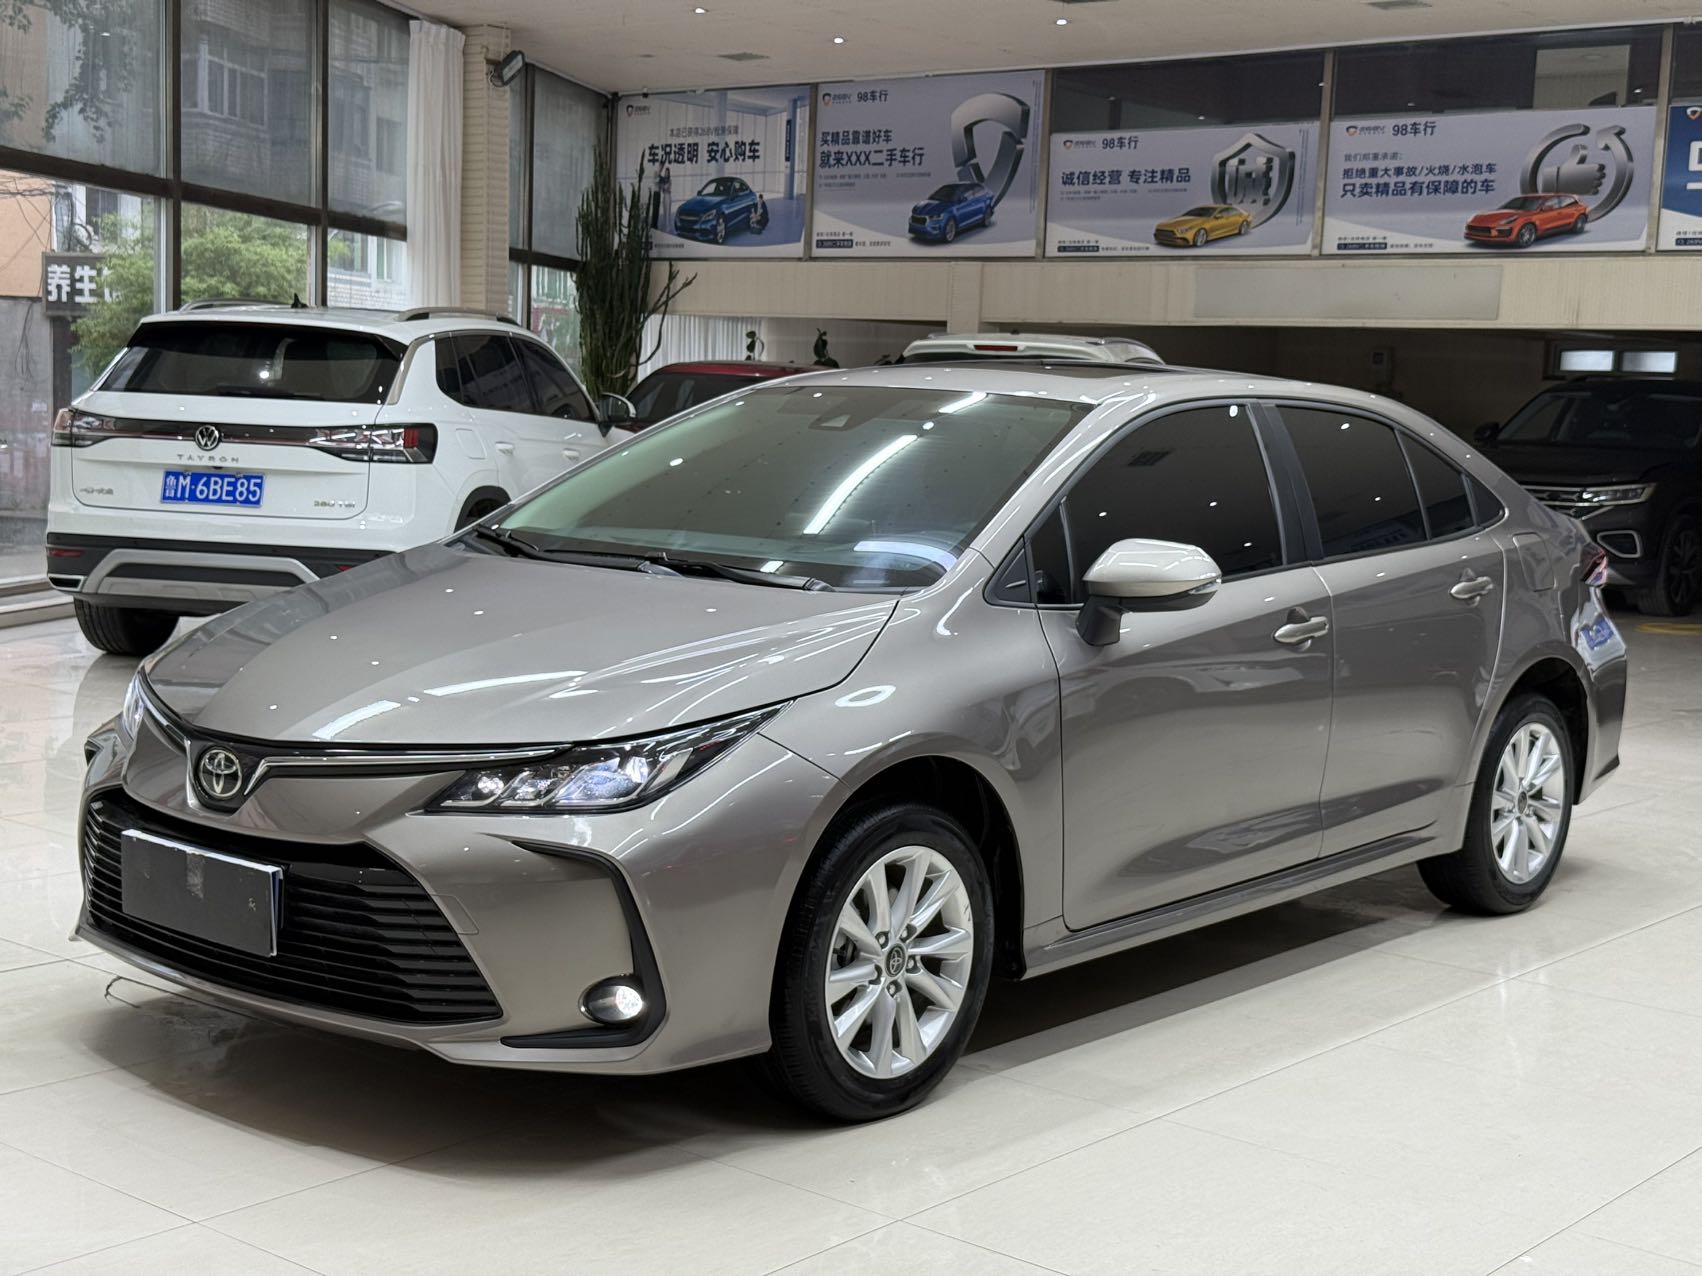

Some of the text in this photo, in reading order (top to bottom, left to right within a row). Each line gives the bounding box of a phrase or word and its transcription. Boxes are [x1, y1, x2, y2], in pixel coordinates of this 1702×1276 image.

[857, 90, 889, 103] 98车行
[1391, 121, 1437, 136] 98车行
[820, 129, 893, 147] 买精品靠谱好车
[1101, 136, 1140, 150] 98车行
[647, 143, 699, 165] 车况透明
[706, 140, 761, 163] 安心购车
[819, 147, 925, 168] 就来XXX二手车行
[1061, 167, 1191, 187] 诚信经营 专注精品
[1340, 178, 1495, 199] 只卖精品有保障的车
[177, 453, 240, 463] TAYRON
